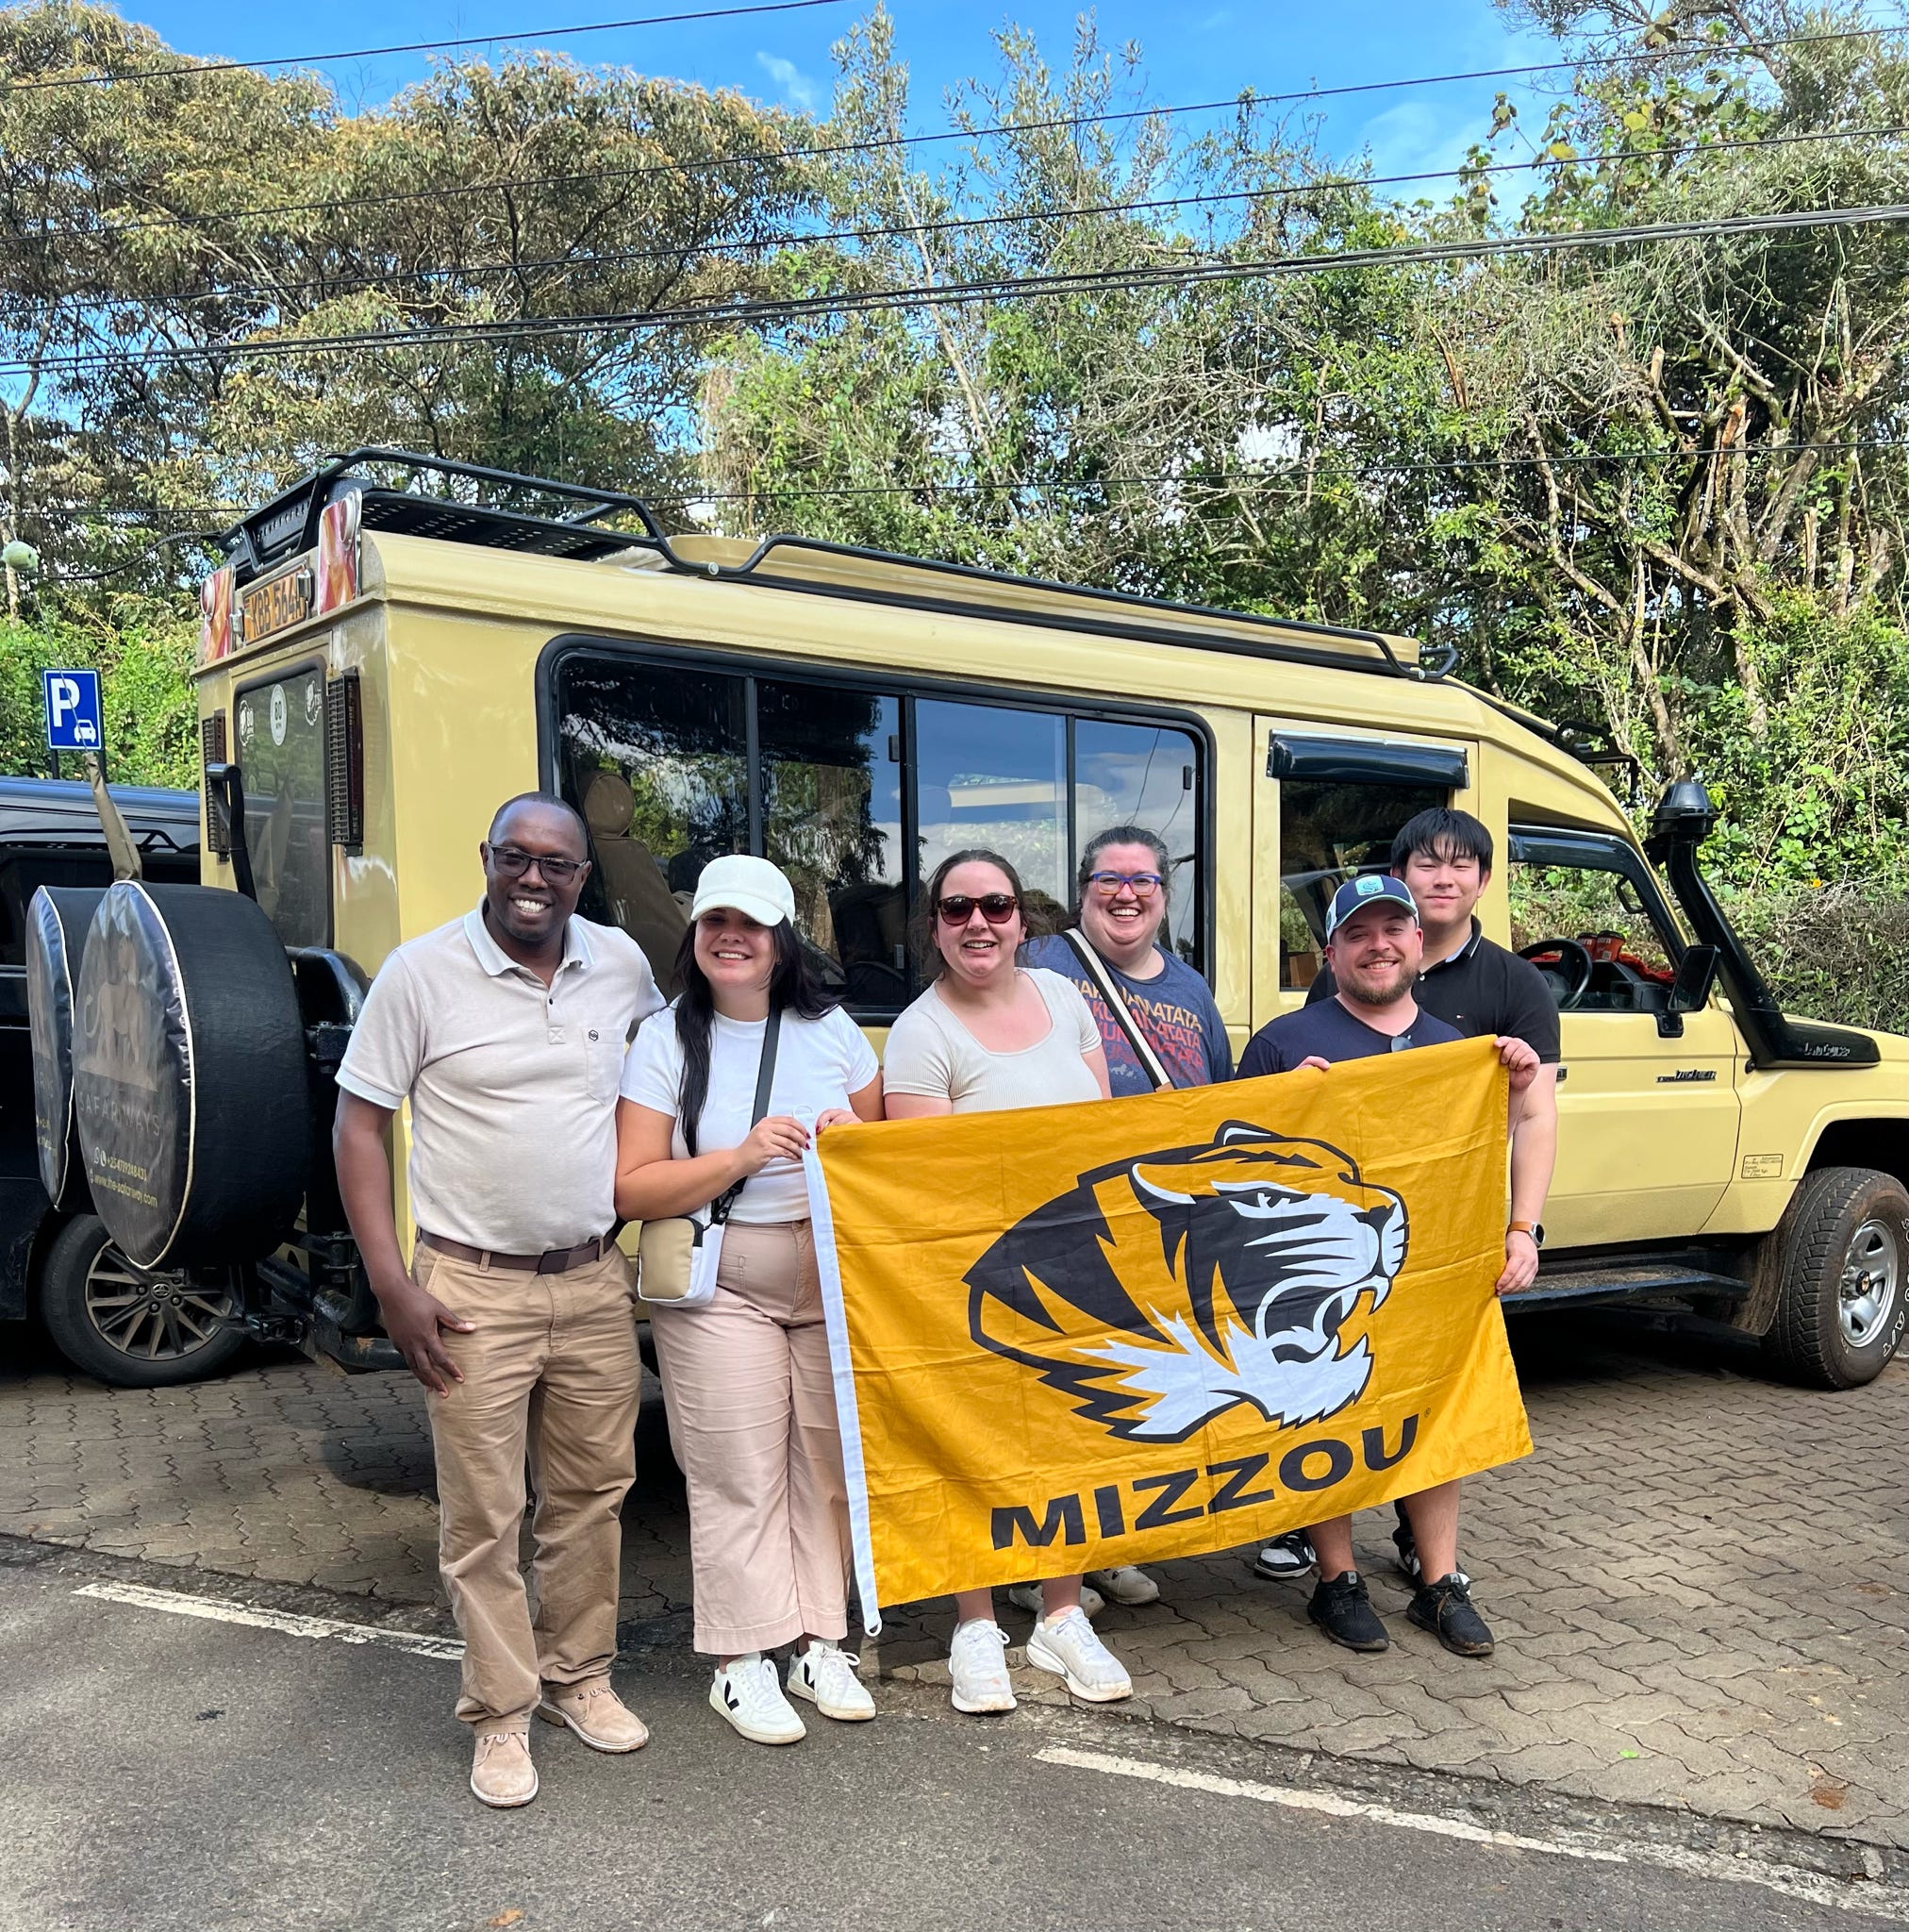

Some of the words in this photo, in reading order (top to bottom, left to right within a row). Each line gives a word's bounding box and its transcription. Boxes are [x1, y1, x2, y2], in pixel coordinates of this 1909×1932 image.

[251, 588, 271, 638] KBB
[50, 677, 80, 727] P
[990, 1412, 1420, 1551] MIZZOU
